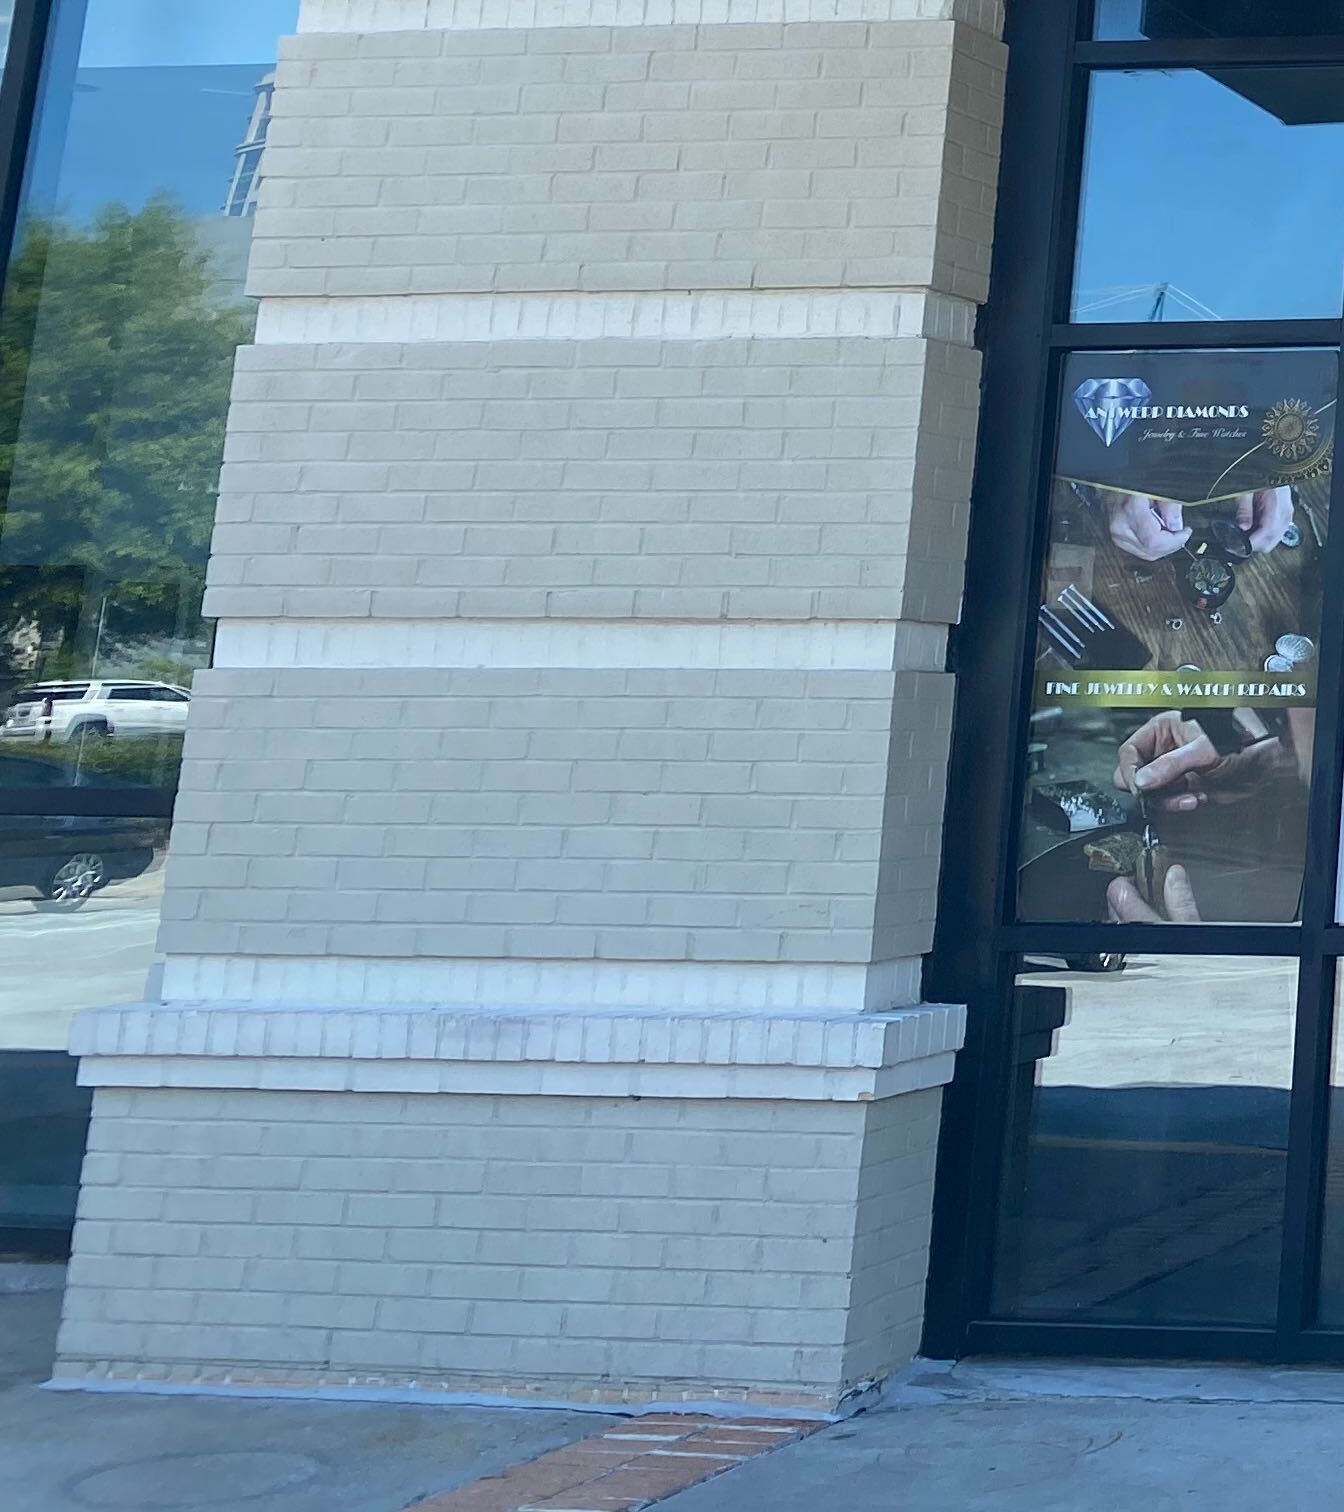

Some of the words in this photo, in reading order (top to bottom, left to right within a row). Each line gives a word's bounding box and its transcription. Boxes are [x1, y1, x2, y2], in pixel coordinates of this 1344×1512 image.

[1084, 405, 1164, 419] ANTWERP
[1166, 405, 1249, 419] DIAMONDS
[1046, 681, 1080, 696] FINE
[1084, 681, 1158, 696] JEWELRY
[1159, 682, 1173, 696] &
[1177, 682, 1236, 696] WATCH
[1237, 682, 1306, 697] REPAIRS
